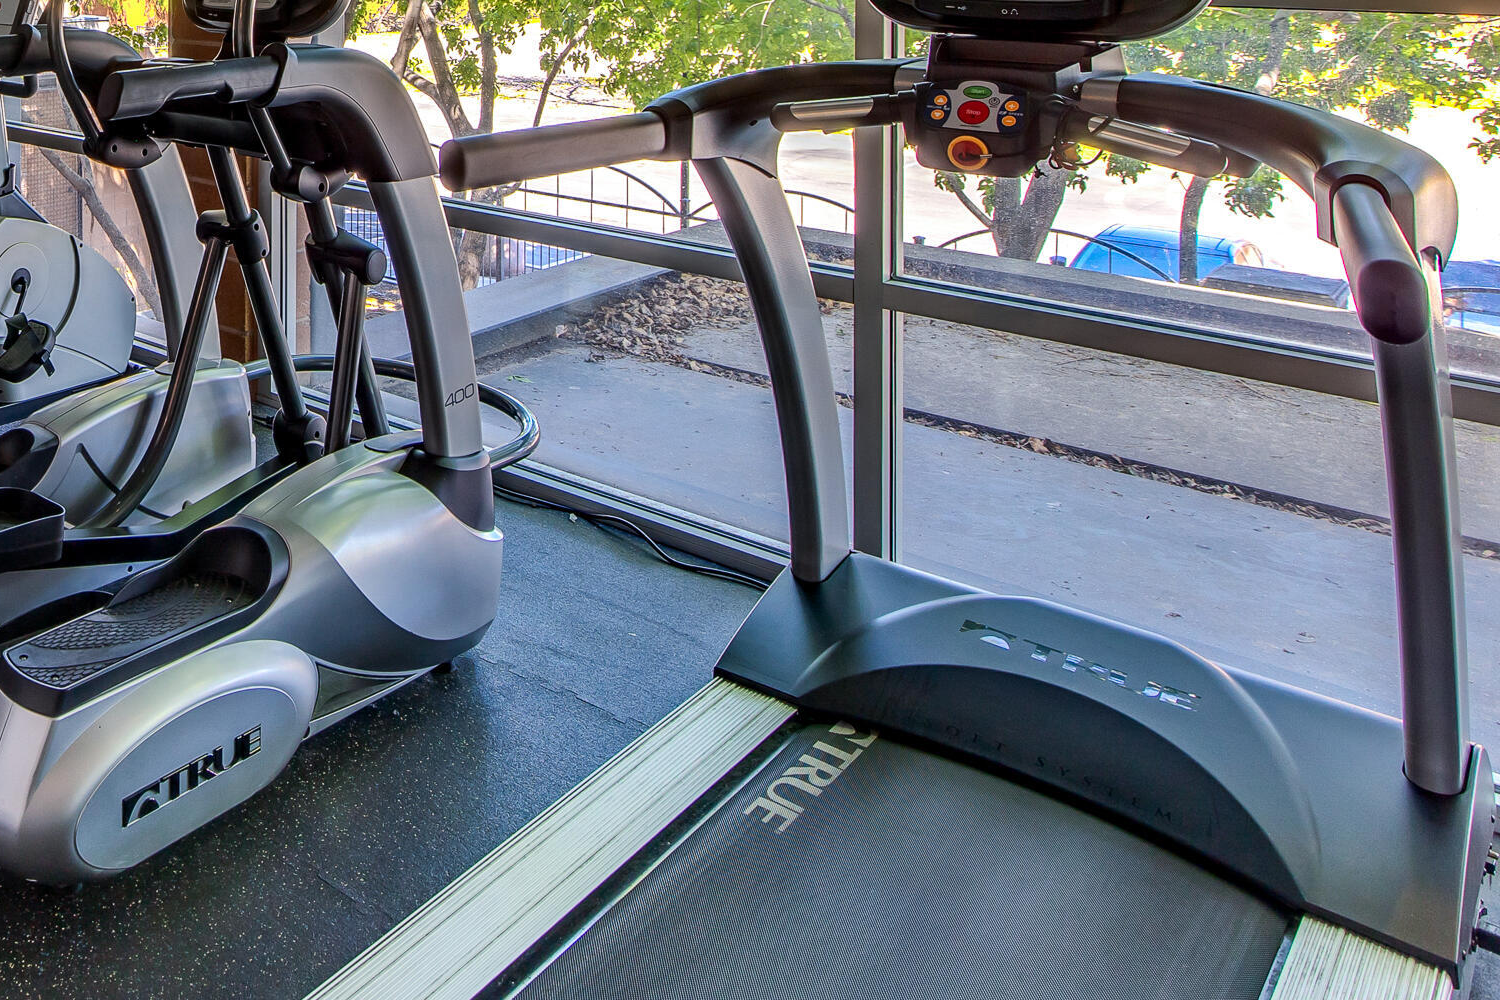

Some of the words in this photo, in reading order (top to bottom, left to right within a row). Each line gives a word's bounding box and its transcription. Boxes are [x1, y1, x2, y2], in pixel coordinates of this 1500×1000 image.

[965, 108, 982, 116] Stop
[444, 382, 475, 408] 400
[160, 722, 262, 802] TRUE
[744, 740, 864, 835] TRUE
